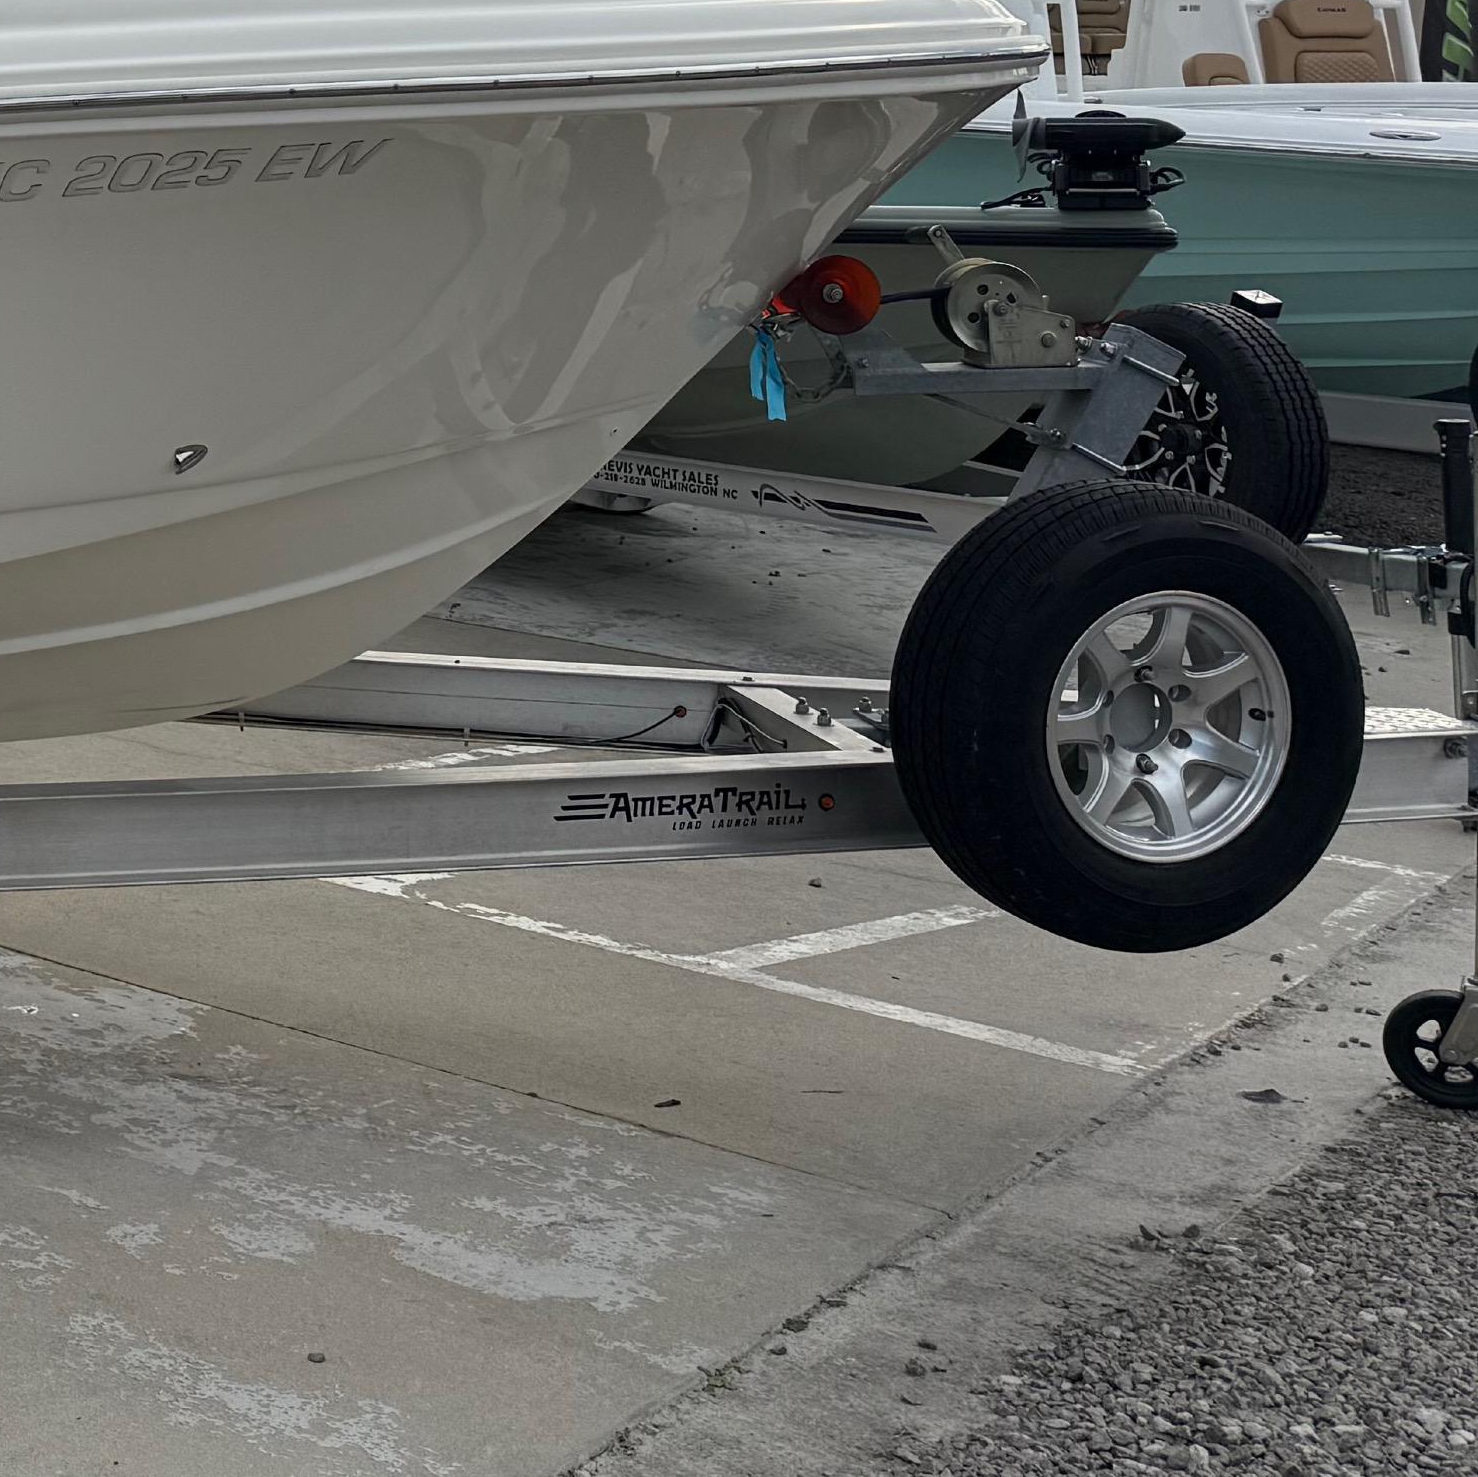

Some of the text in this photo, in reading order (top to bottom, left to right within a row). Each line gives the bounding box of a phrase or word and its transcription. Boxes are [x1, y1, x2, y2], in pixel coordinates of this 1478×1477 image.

[61, 147, 252, 197] 2025
[254, 138, 395, 182] EW
[636, 464, 679, 481] YACHT
[682, 471, 719, 487] SALES
[651, 478, 718, 497] WILMINGTON
[722, 488, 739, 500] NC
[672, 815, 805, 831] LOAD LAUNCH RELAX
